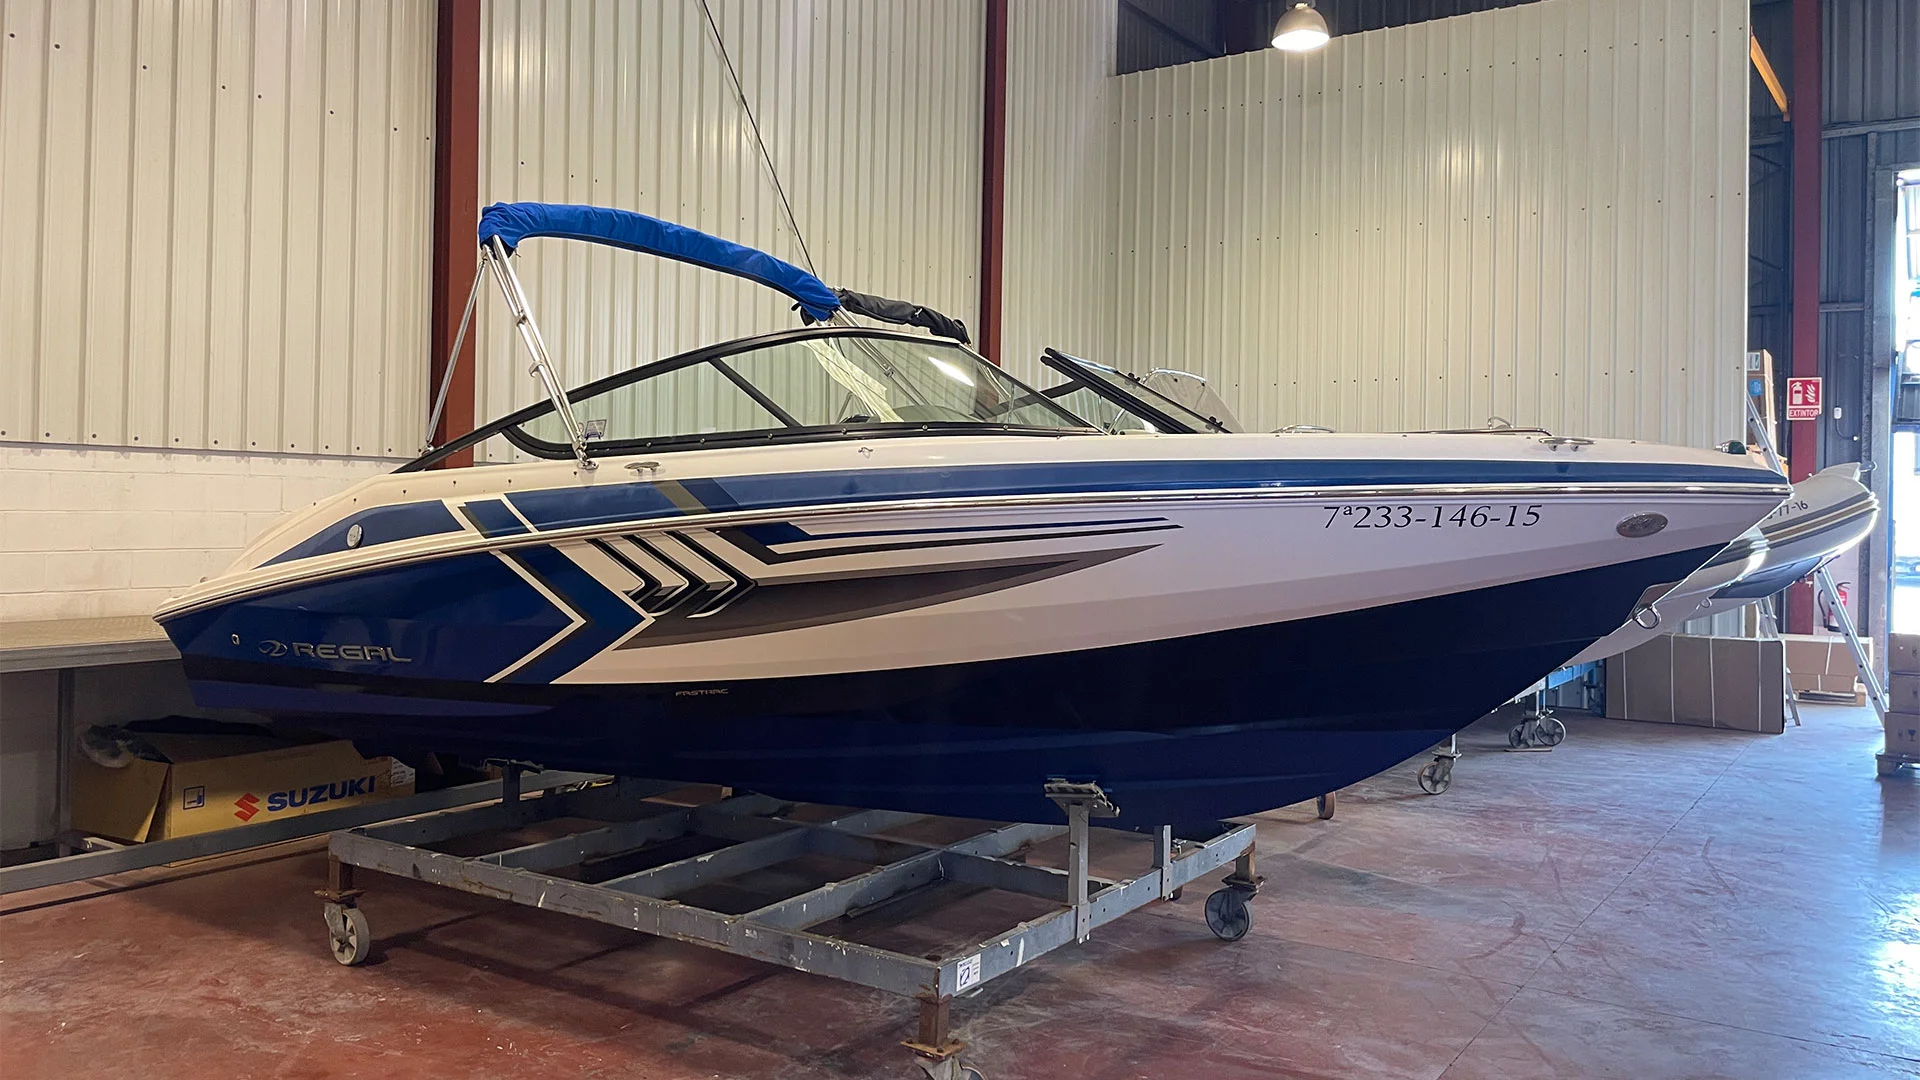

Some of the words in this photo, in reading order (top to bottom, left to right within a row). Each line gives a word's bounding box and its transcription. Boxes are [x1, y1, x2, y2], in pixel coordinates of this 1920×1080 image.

[1789, 409, 1819, 417] EXTINTOR
[292, 642, 412, 662] REGAL
[675, 688, 729, 697] FASTRAC
[267, 775, 375, 812] SUZUKI
